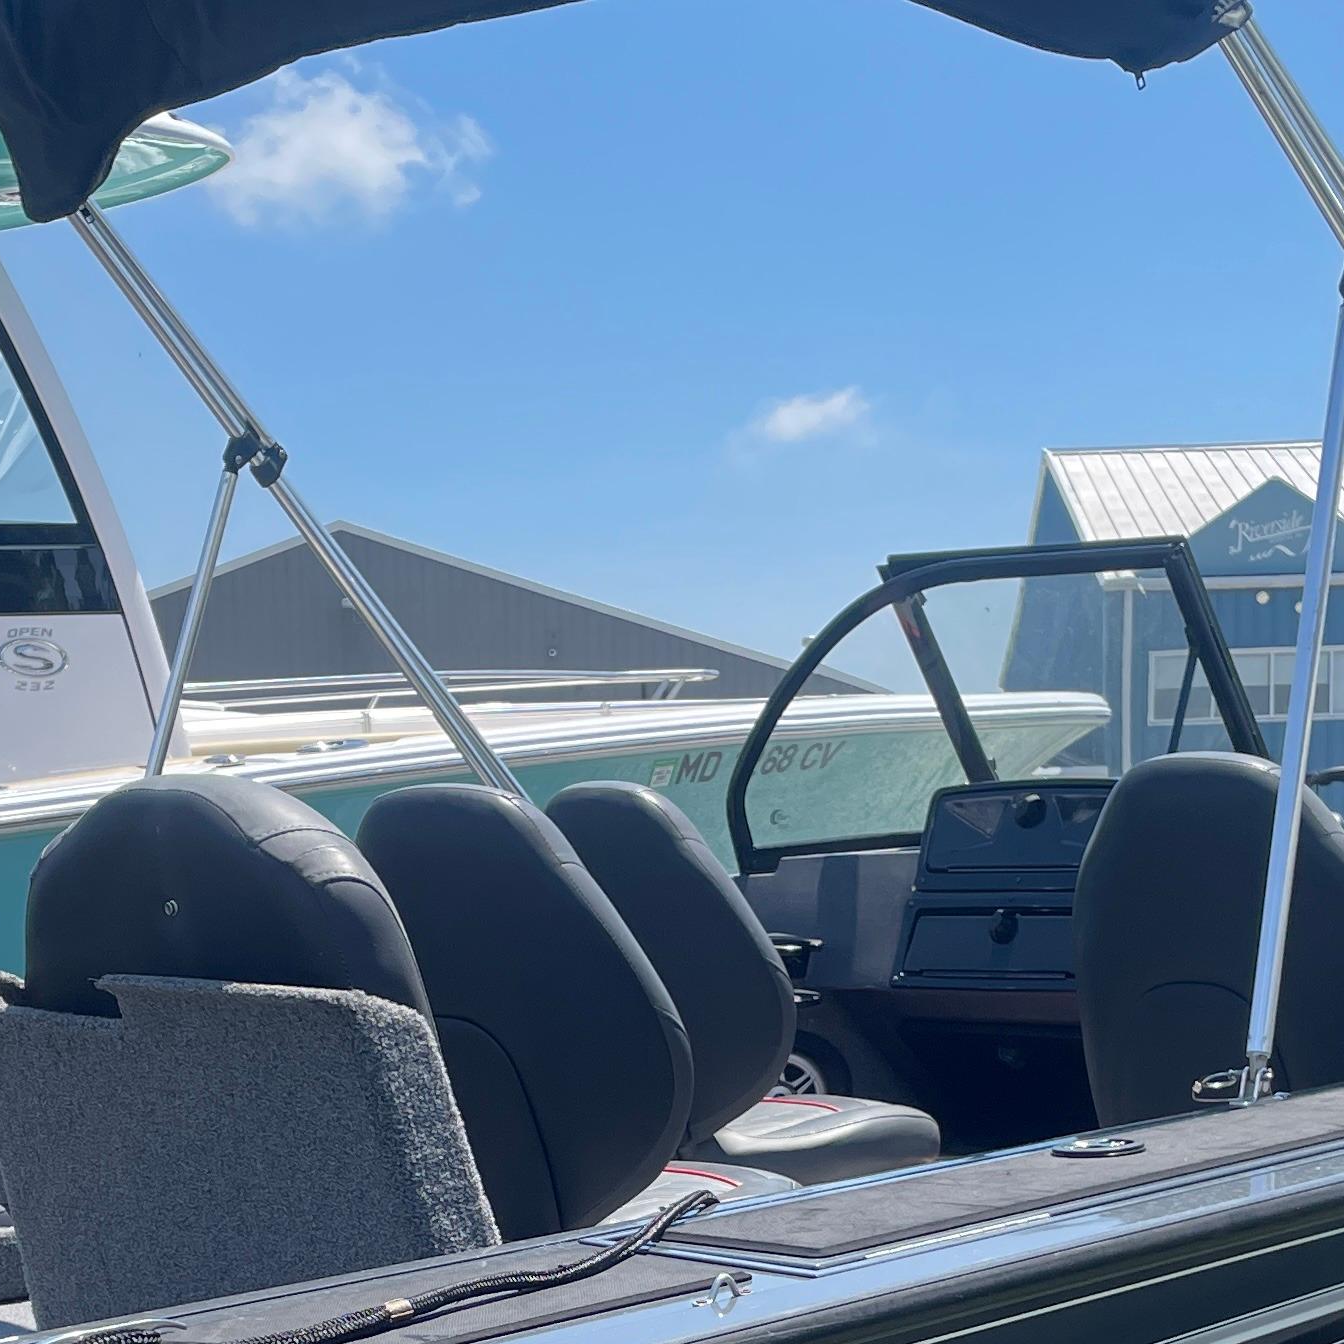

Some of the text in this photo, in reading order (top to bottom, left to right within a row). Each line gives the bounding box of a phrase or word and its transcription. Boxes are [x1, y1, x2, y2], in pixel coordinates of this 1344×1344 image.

[7, 627, 53, 638] OPEN
[14, 680, 55, 691] 232
[675, 751, 722, 784] MD
[800, 740, 846, 770] CV
